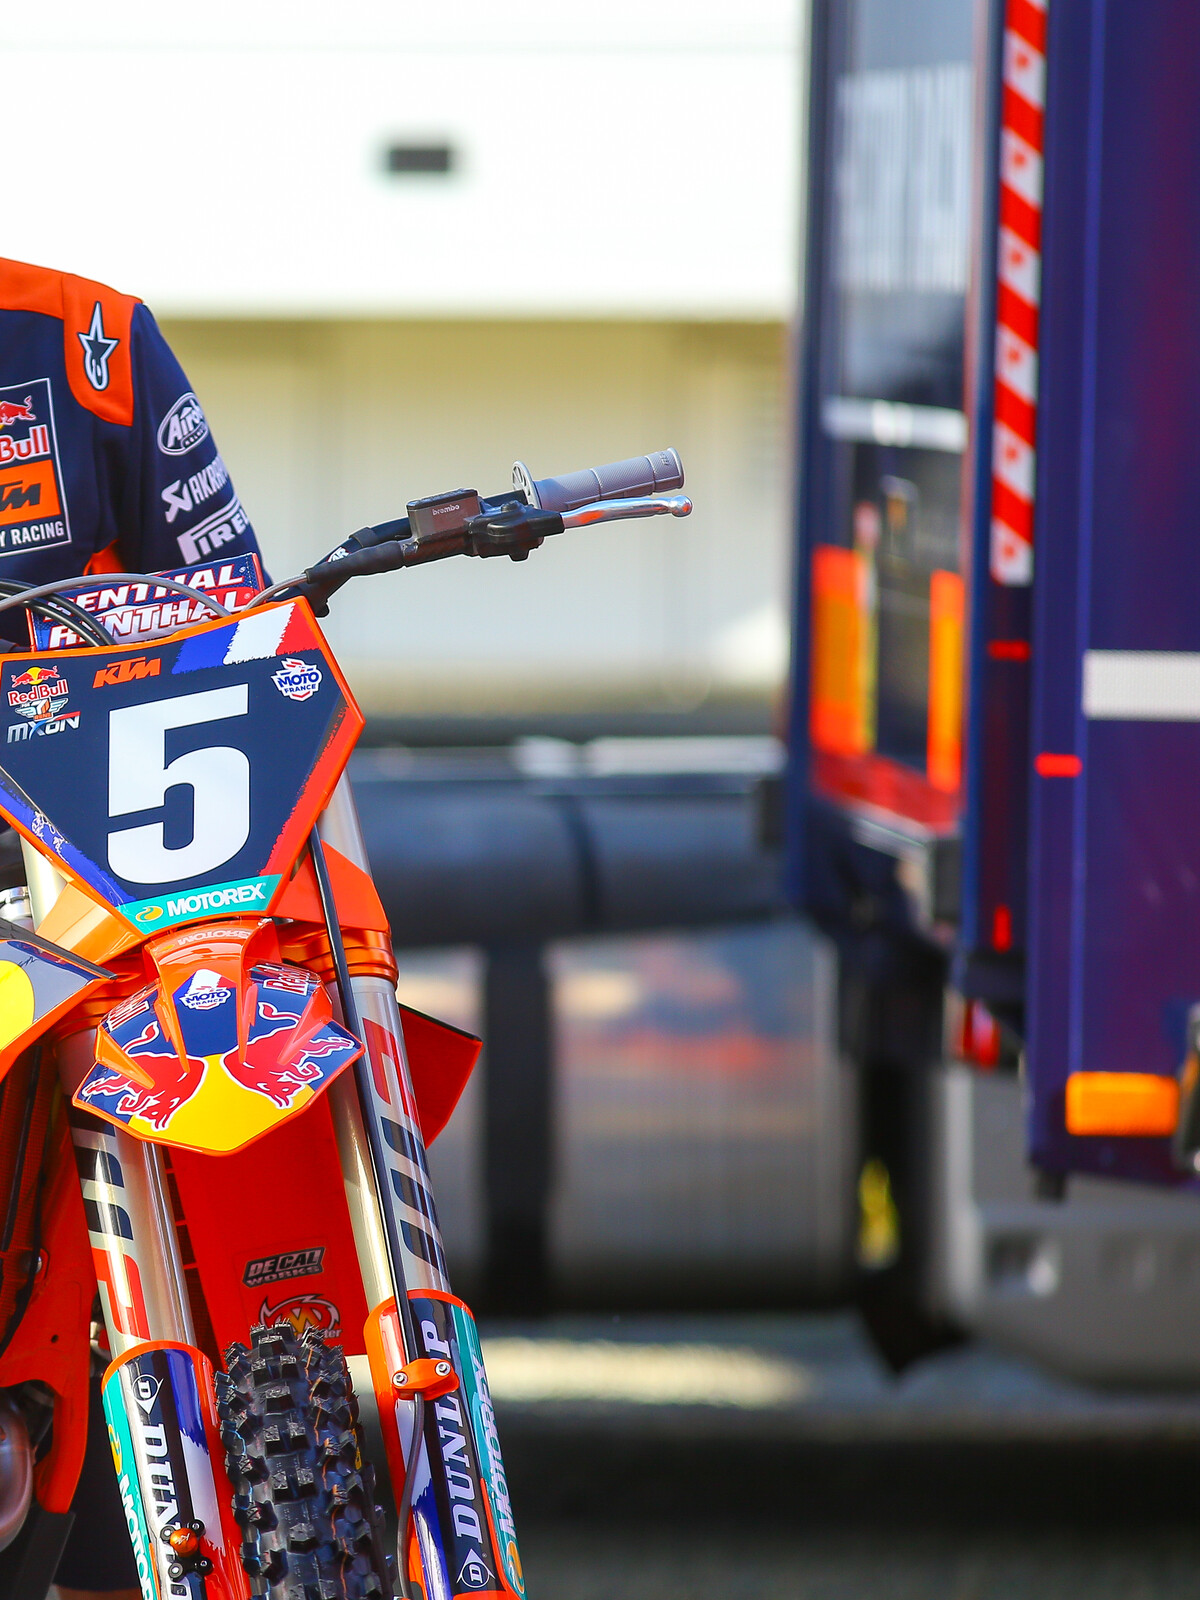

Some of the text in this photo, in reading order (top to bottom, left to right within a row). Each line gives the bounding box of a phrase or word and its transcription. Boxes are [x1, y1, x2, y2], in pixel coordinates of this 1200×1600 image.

[431, 504, 460, 516] brembo
[11, 521, 64, 546] RACING
[176, 508, 249, 565] PIREL
[92, 656, 161, 688] KTM
[278, 671, 319, 688] MOTO
[7, 679, 69, 706] Red Bull
[284, 684, 316, 693] FRANCE
[108, 684, 250, 884] 5
[167, 884, 266, 917] MOTOREX
[186, 989, 228, 1003] MOTO
[191, 998, 224, 1007] FRANCE
[420, 1319, 484, 1545] DUNLP
